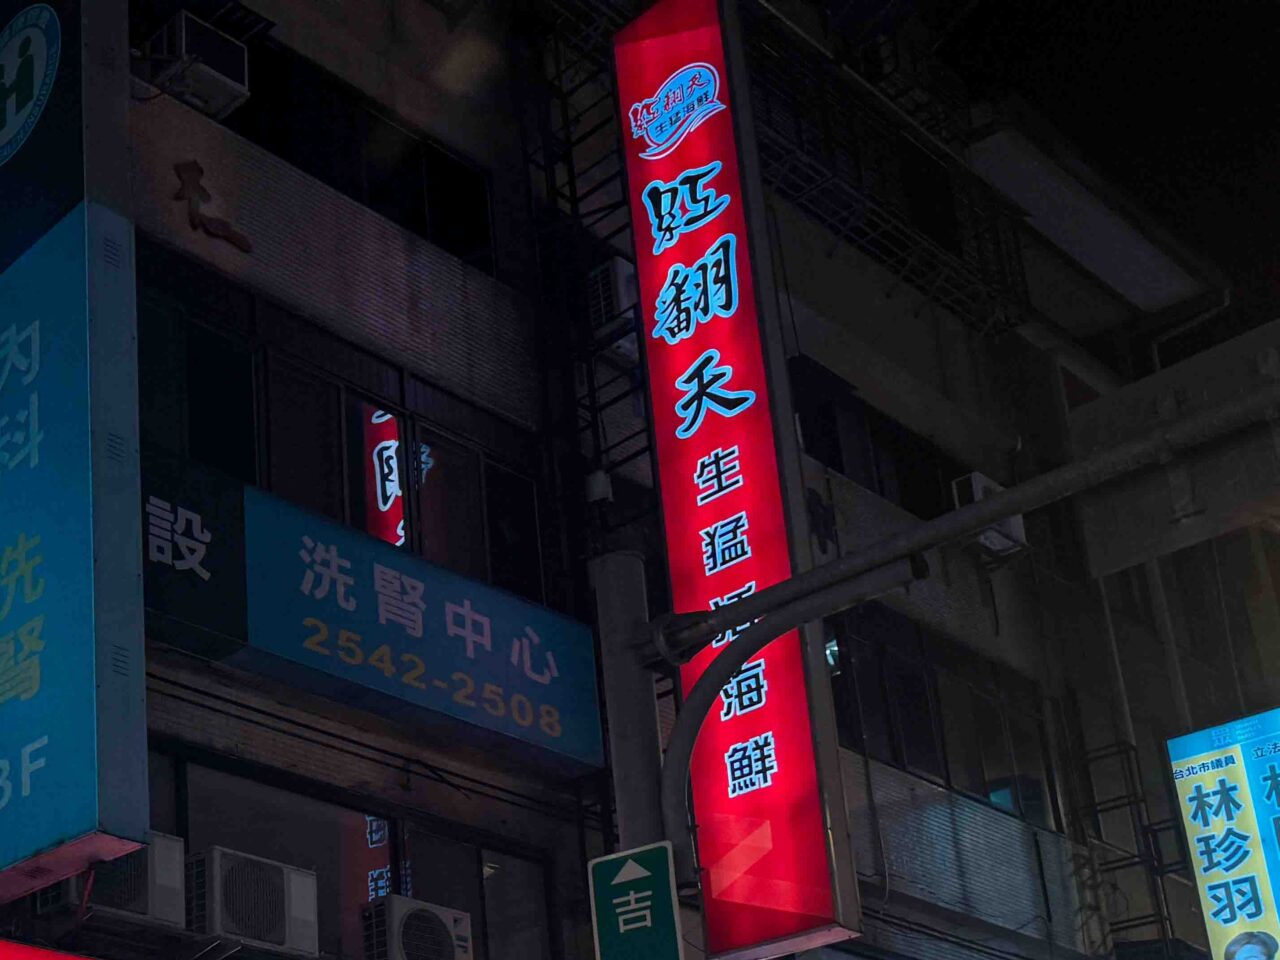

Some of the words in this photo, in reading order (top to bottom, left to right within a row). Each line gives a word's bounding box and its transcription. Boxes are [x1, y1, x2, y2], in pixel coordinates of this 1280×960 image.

[297, 533, 560, 687] 洗腎中心
[300, 614, 564, 739] 2542-2508
[1187, 778, 1263, 925] 林珍羽
